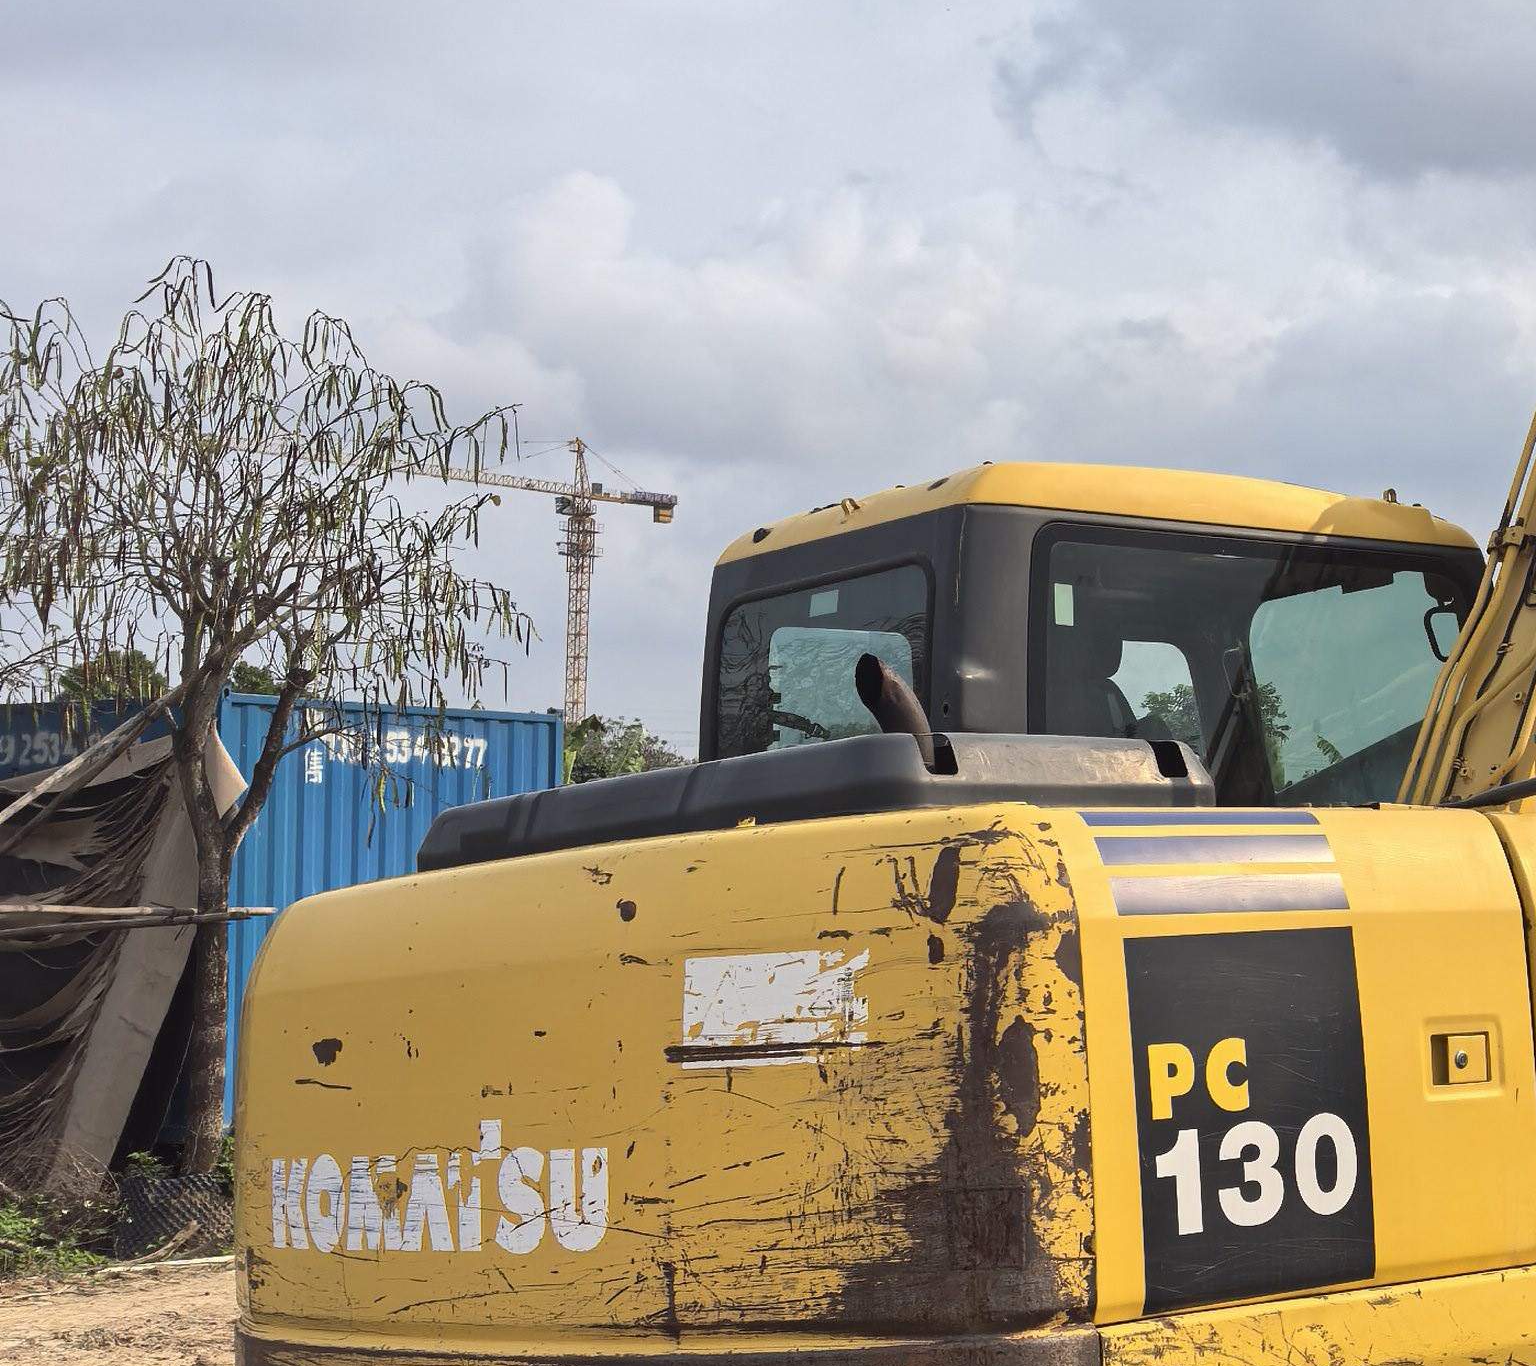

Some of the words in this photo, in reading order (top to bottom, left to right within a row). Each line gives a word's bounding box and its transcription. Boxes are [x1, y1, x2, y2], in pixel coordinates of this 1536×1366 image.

[1147, 1037, 1251, 1121] PC
[271, 1118, 610, 1255] KOMATSU
[1155, 1112, 1358, 1236] 130
